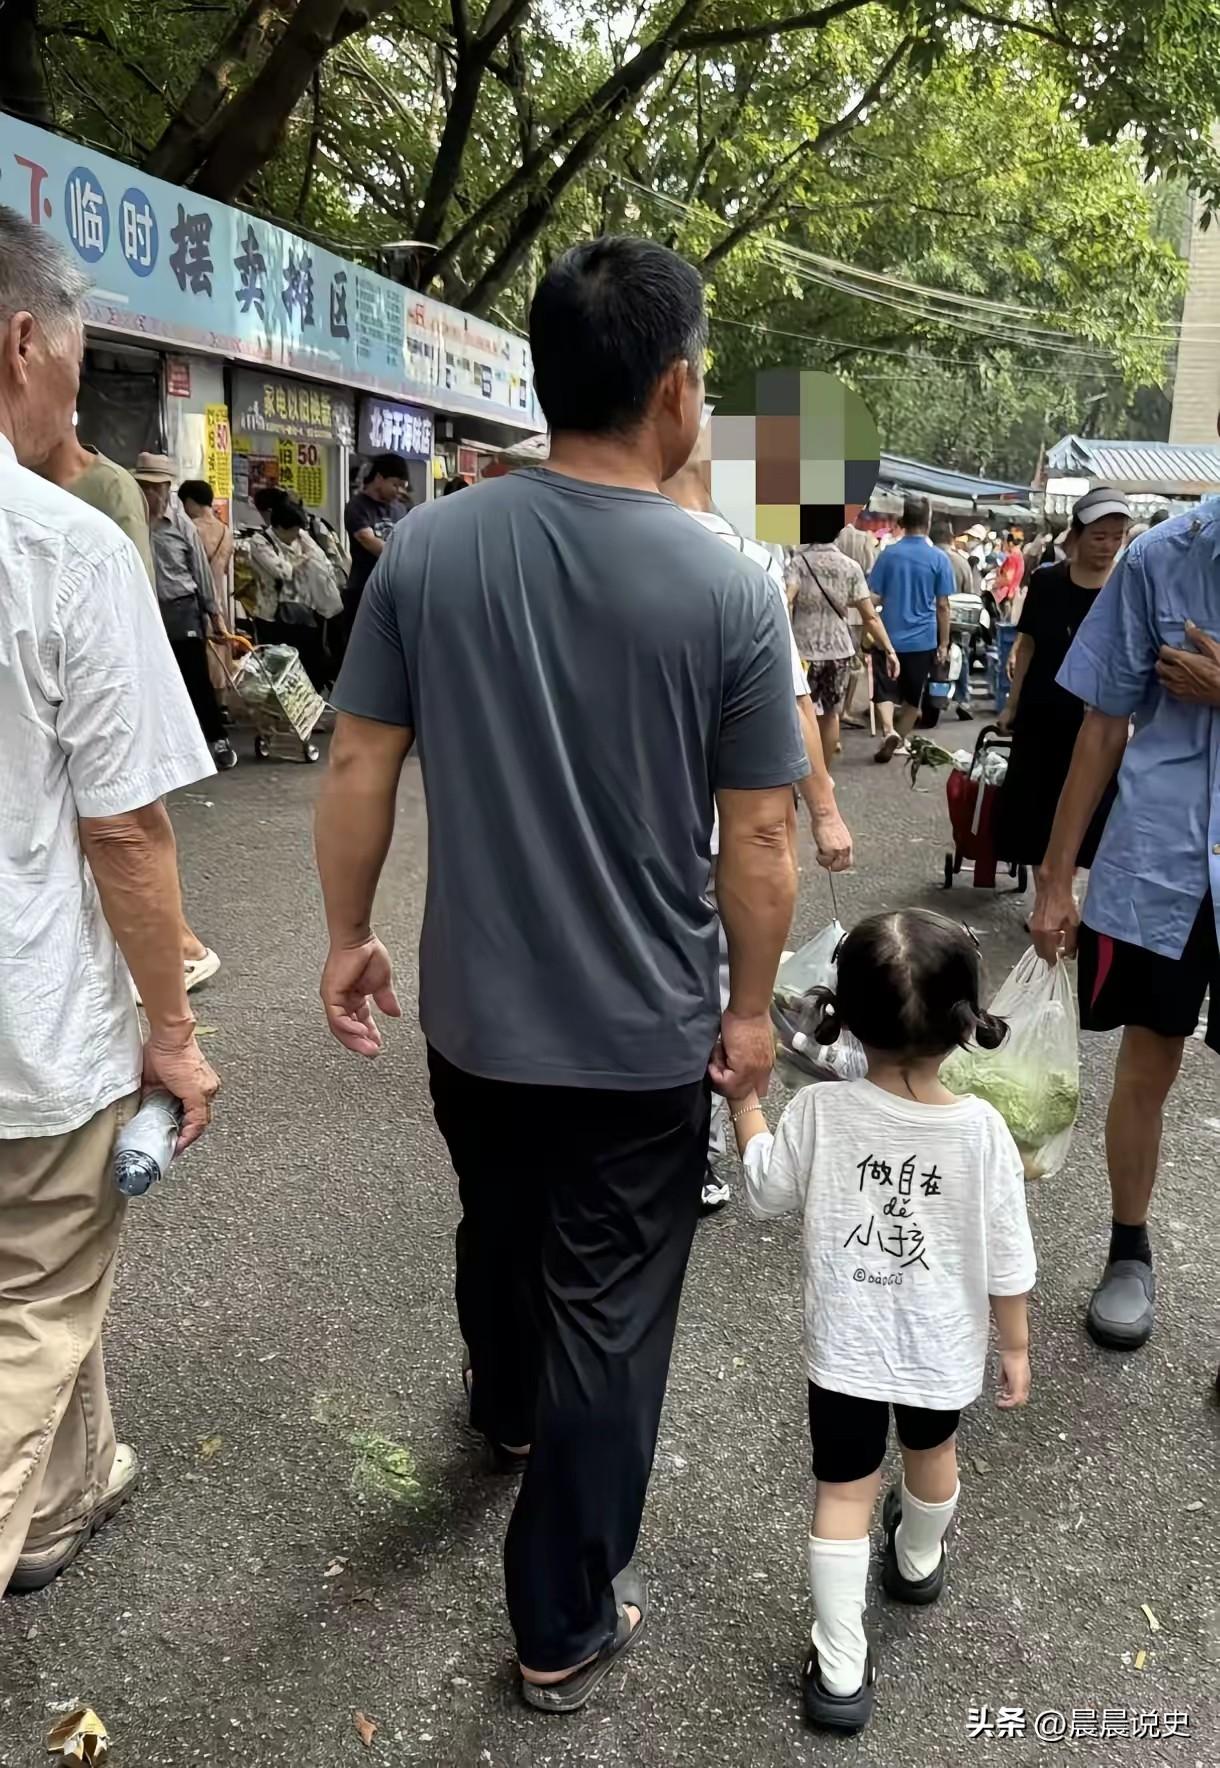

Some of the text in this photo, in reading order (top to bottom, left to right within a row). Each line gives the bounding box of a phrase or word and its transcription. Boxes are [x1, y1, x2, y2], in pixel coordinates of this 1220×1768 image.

[297, 443, 318, 466] 50
[856, 1153, 942, 1196] 做自在
[843, 1214, 930, 1271] 小孩
